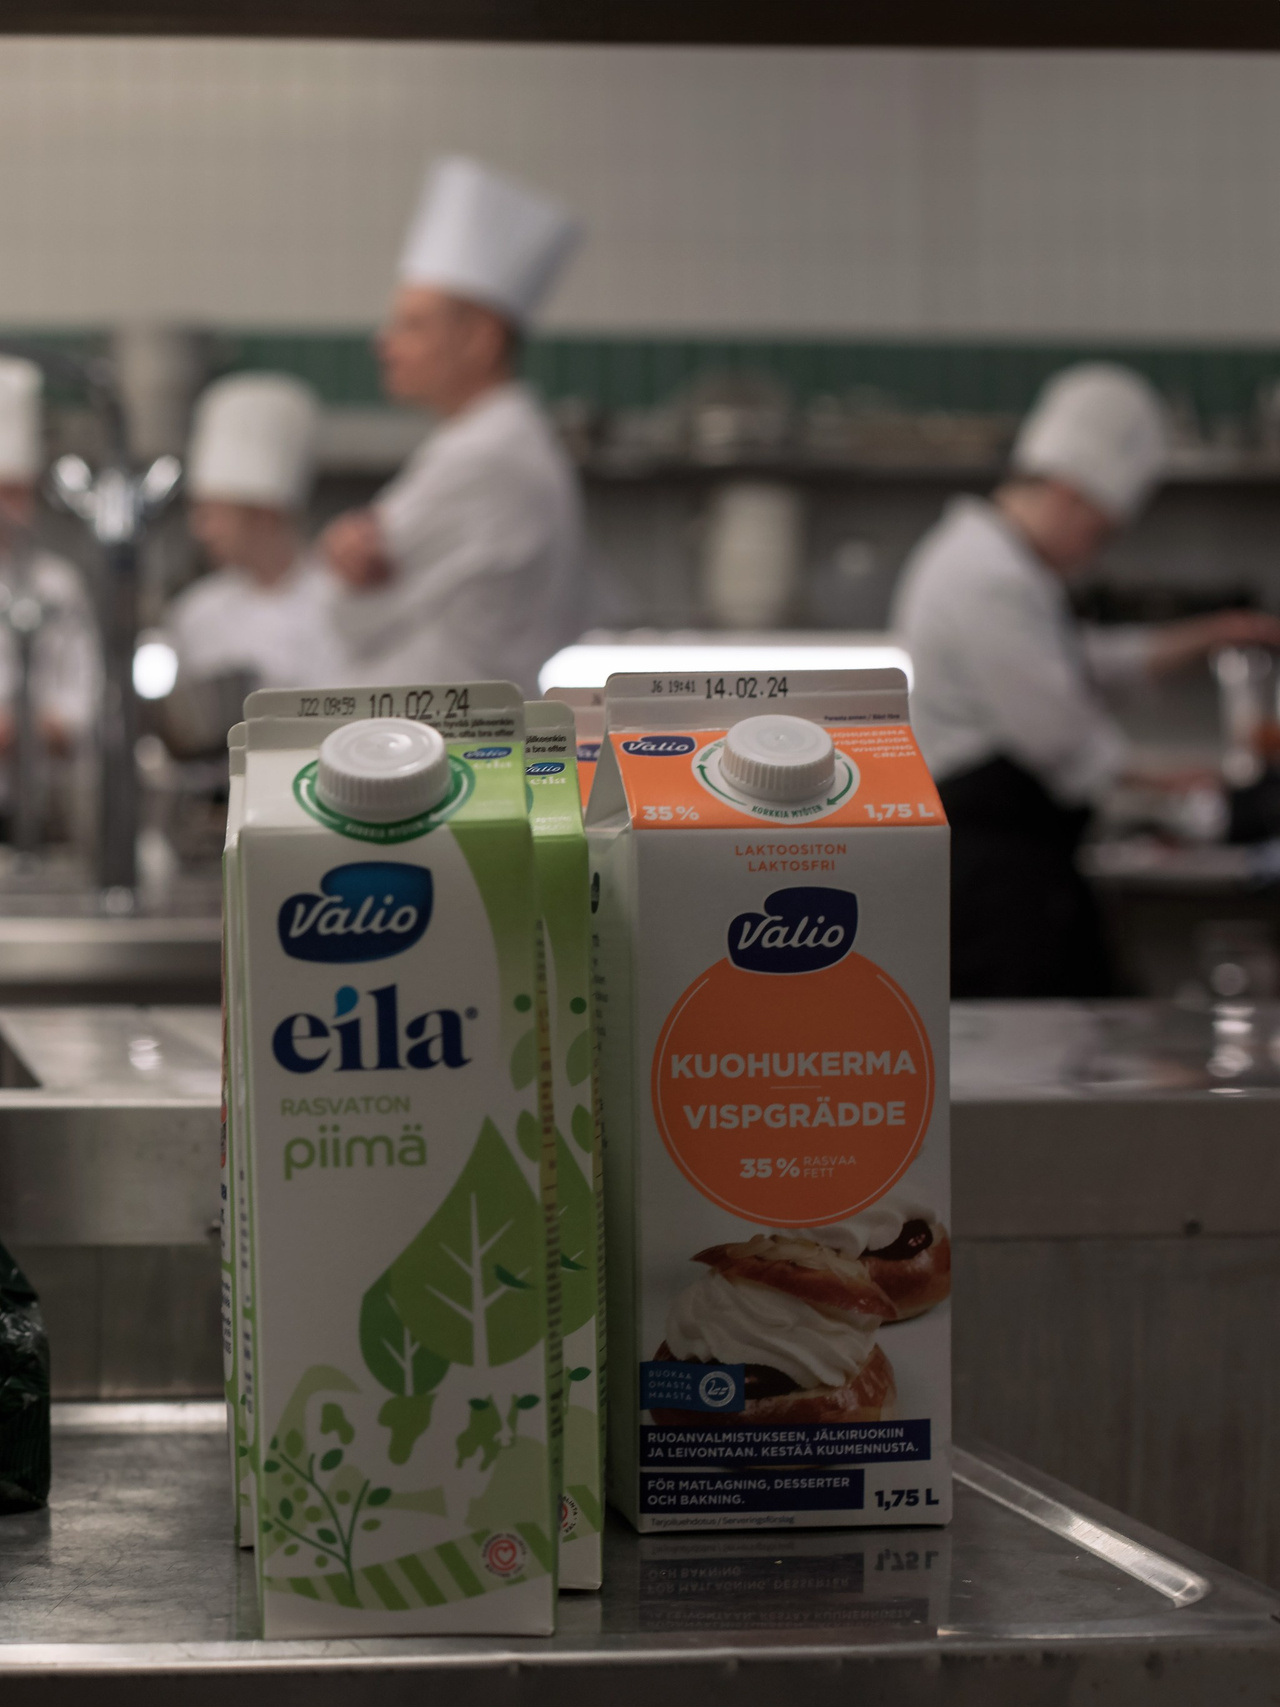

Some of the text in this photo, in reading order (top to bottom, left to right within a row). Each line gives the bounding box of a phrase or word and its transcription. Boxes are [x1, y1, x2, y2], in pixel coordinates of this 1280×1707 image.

[650, 676, 789, 699] J6 19:41 14.02.24
[297, 697, 319, 717] J22
[369, 688, 470, 720] 10.02.24
[627, 741, 690, 752] Valio
[752, 804, 824, 819] KORKKIA MYÖTEN
[863, 803, 934, 821] 1,75 L
[735, 844, 847, 857] LAKTOOSITON
[748, 860, 836, 873] LAKTOSFRI
[288, 894, 419, 938] Valio
[737, 915, 845, 951] Valio
[670, 1049, 917, 1080] KUOHUKERMA
[280, 1096, 412, 1117] RASVATON
[682, 1095, 907, 1130] VISPGRÄDDE
[283, 1122, 427, 1181] piimä
[802, 1155, 857, 1167] RASVAA
[803, 1167, 835, 1179] FETT
[648, 1380, 692, 1391] OMASTA
[648, 1391, 692, 1401] MAASTA
[647, 1427, 905, 1445] RUOANVALMISTUKSEEN, JÄLKIRUOKIIN
[646, 1442, 919, 1459] JA LEIVONTAAN. KESTÄÄ KUUMENNUSTA.
[647, 1476, 851, 1492] FÖR MATLAGNING, DESSERTER
[647, 1492, 746, 1506] OCH BAKNING.
[874, 1487, 940, 1510] 1,75 L
